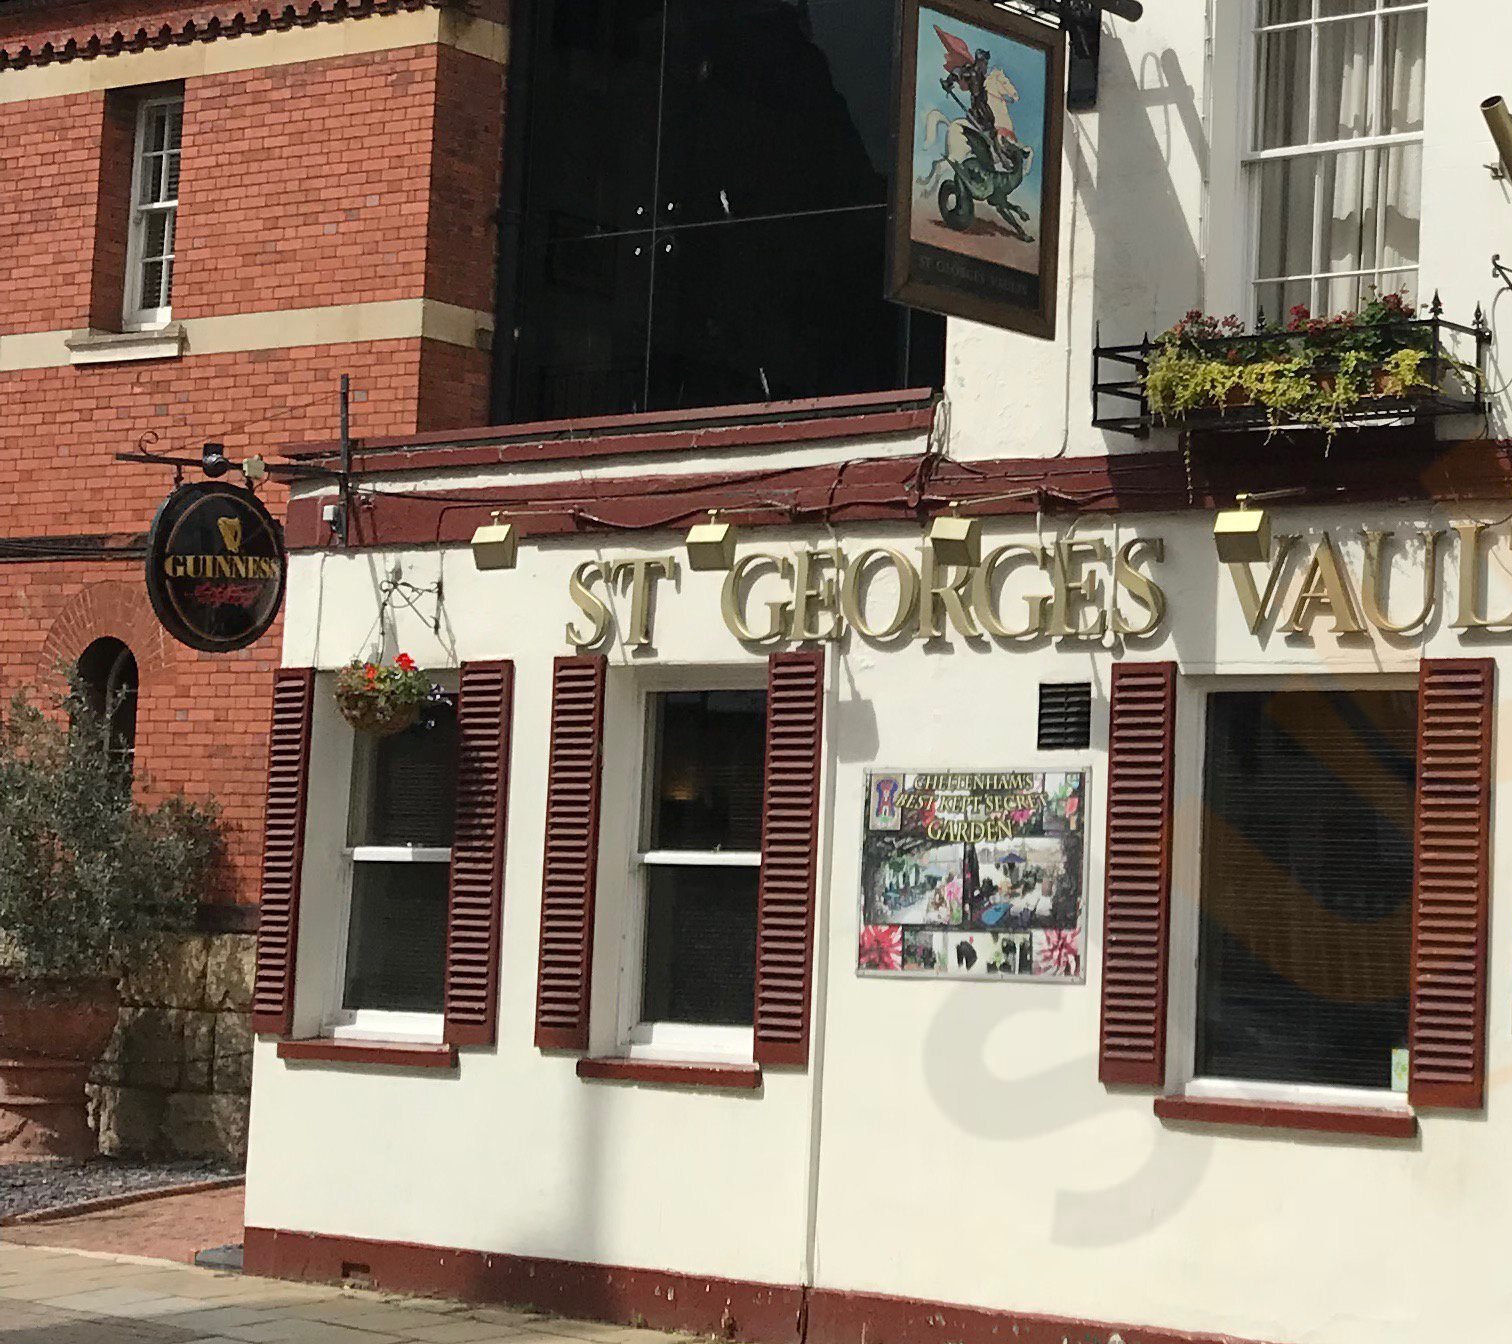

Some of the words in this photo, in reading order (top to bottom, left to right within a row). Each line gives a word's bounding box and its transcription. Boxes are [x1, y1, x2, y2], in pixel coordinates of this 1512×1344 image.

[164, 555, 280, 579] GUINNESS
[566, 556, 681, 649] ST
[721, 536, 1166, 646] GEORGES
[896, 794, 934, 810] BEST
[936, 795, 982, 813] KEPT
[984, 793, 1048, 813] SECRET
[927, 820, 1013, 843] GARDEN
